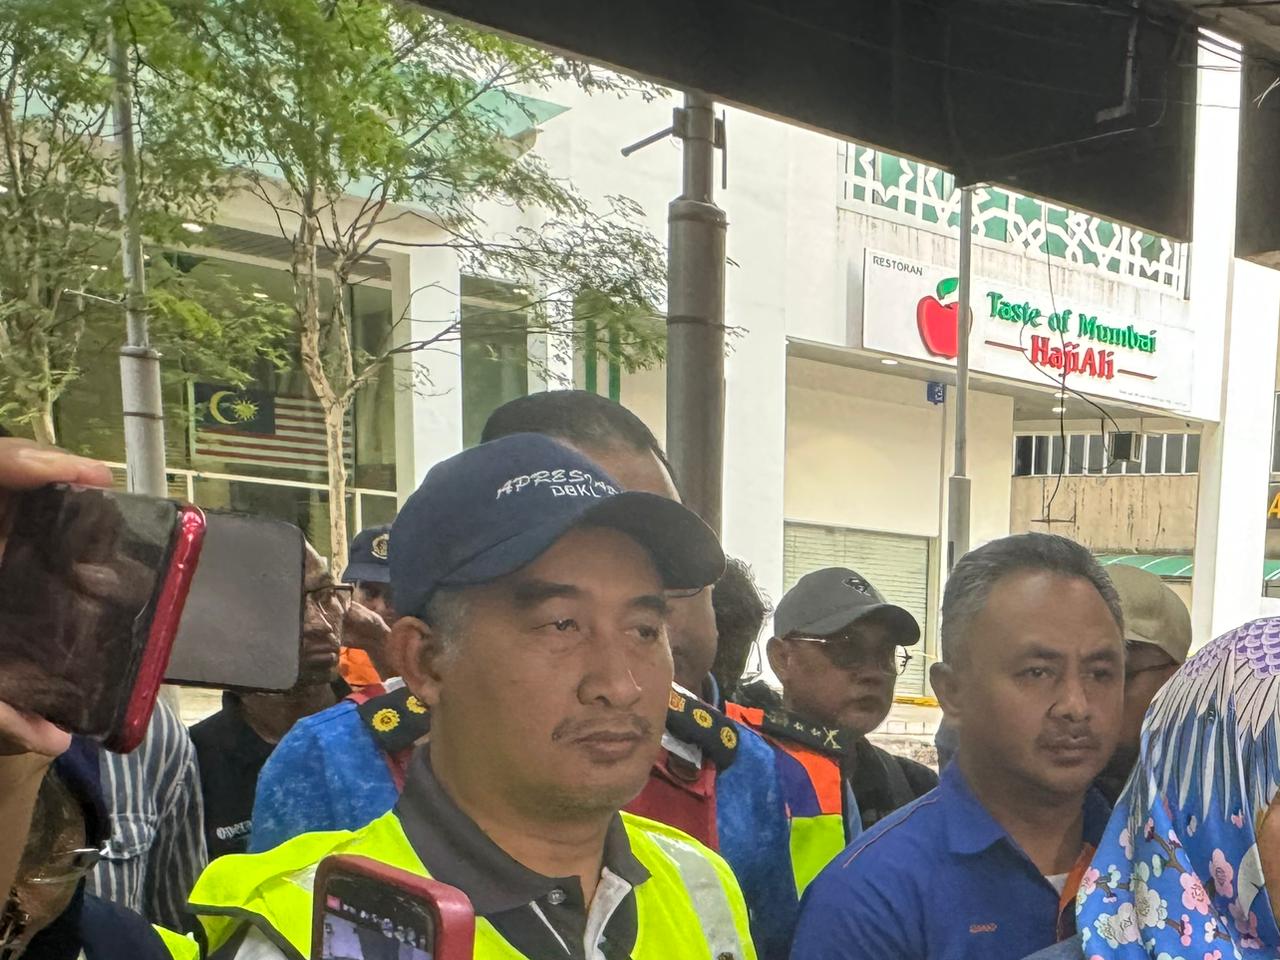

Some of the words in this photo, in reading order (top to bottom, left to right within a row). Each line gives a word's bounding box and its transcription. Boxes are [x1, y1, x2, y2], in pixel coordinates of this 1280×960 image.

[873, 255, 923, 276] RESTORAN
[986, 291, 1042, 328] Taste
[1047, 309, 1070, 334] of
[1078, 312, 1156, 353] Mumbai
